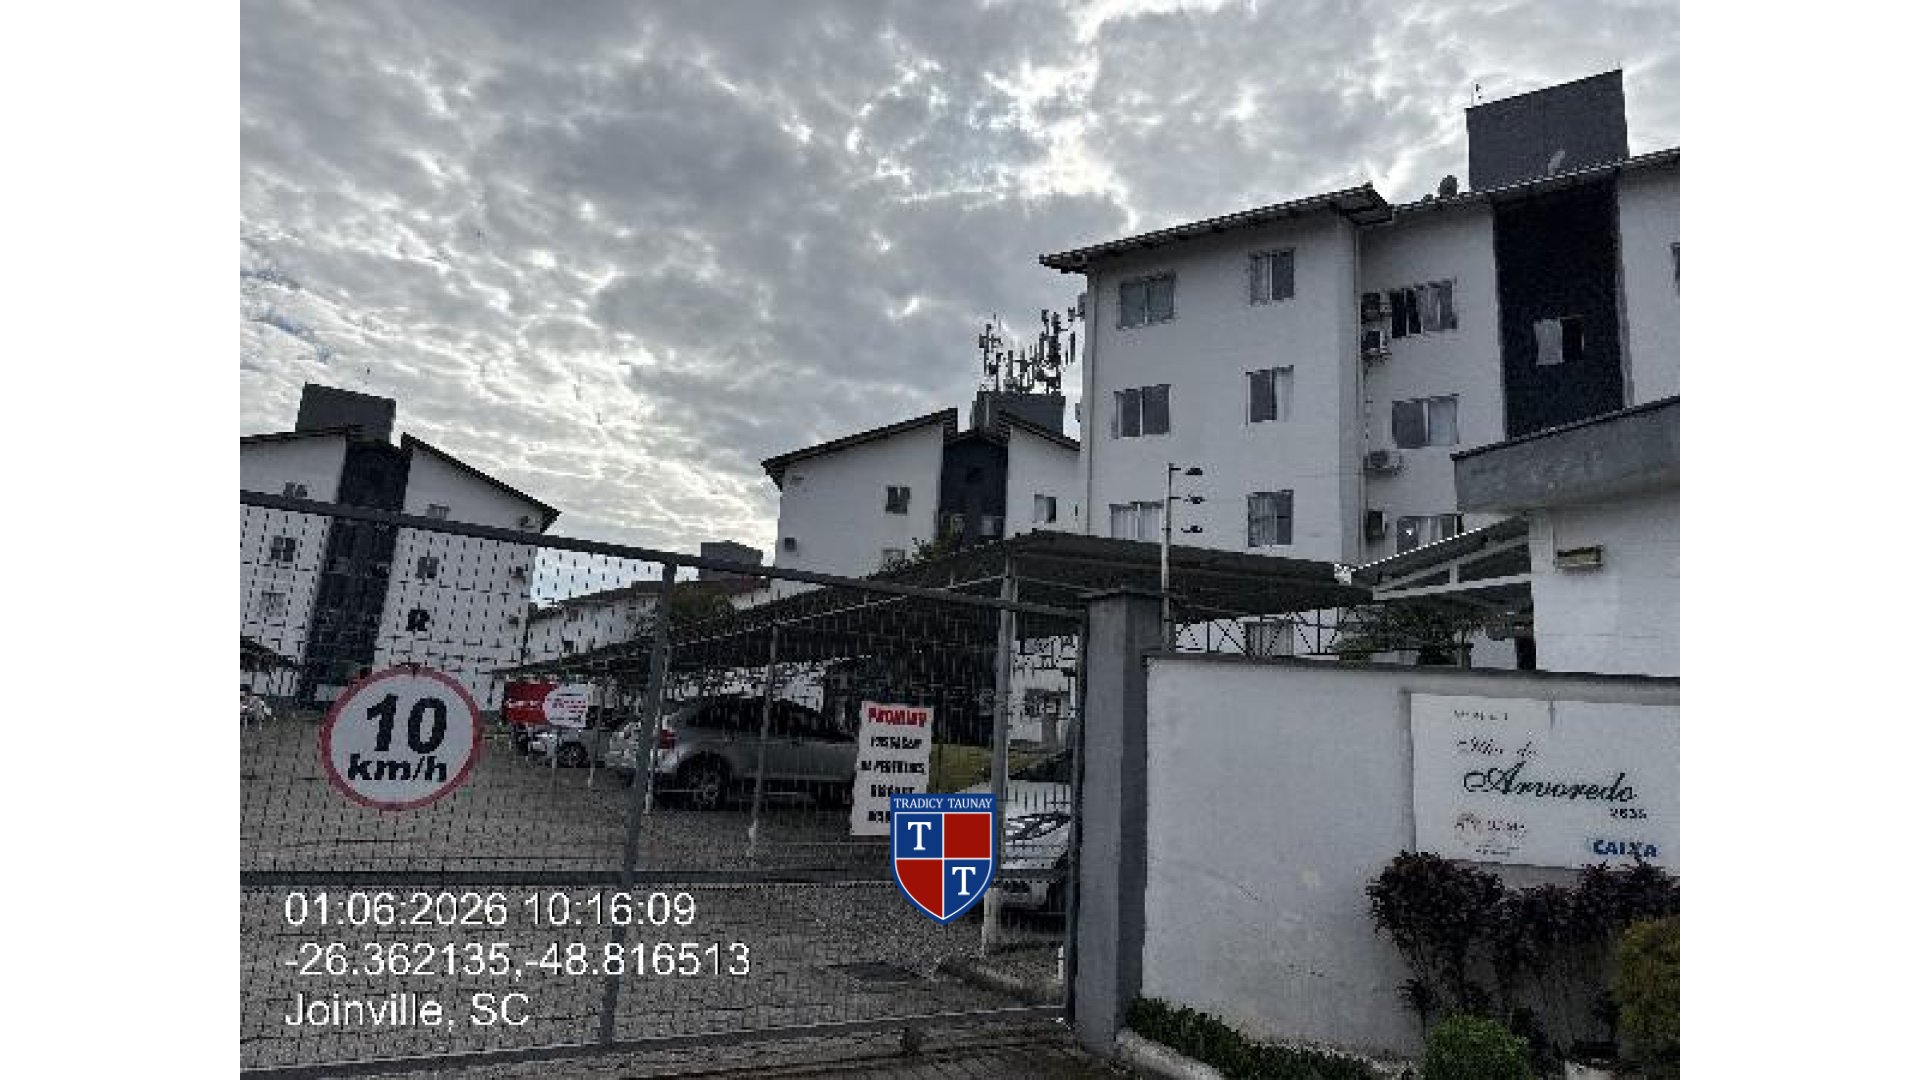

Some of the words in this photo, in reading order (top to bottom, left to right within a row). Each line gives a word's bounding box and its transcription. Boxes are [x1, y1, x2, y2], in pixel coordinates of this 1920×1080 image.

[366, 694, 448, 754] 10
[347, 754, 448, 783] km/h
[1463, 760, 1638, 803] Arvoredo
[1592, 839, 1658, 858] CAIXA
